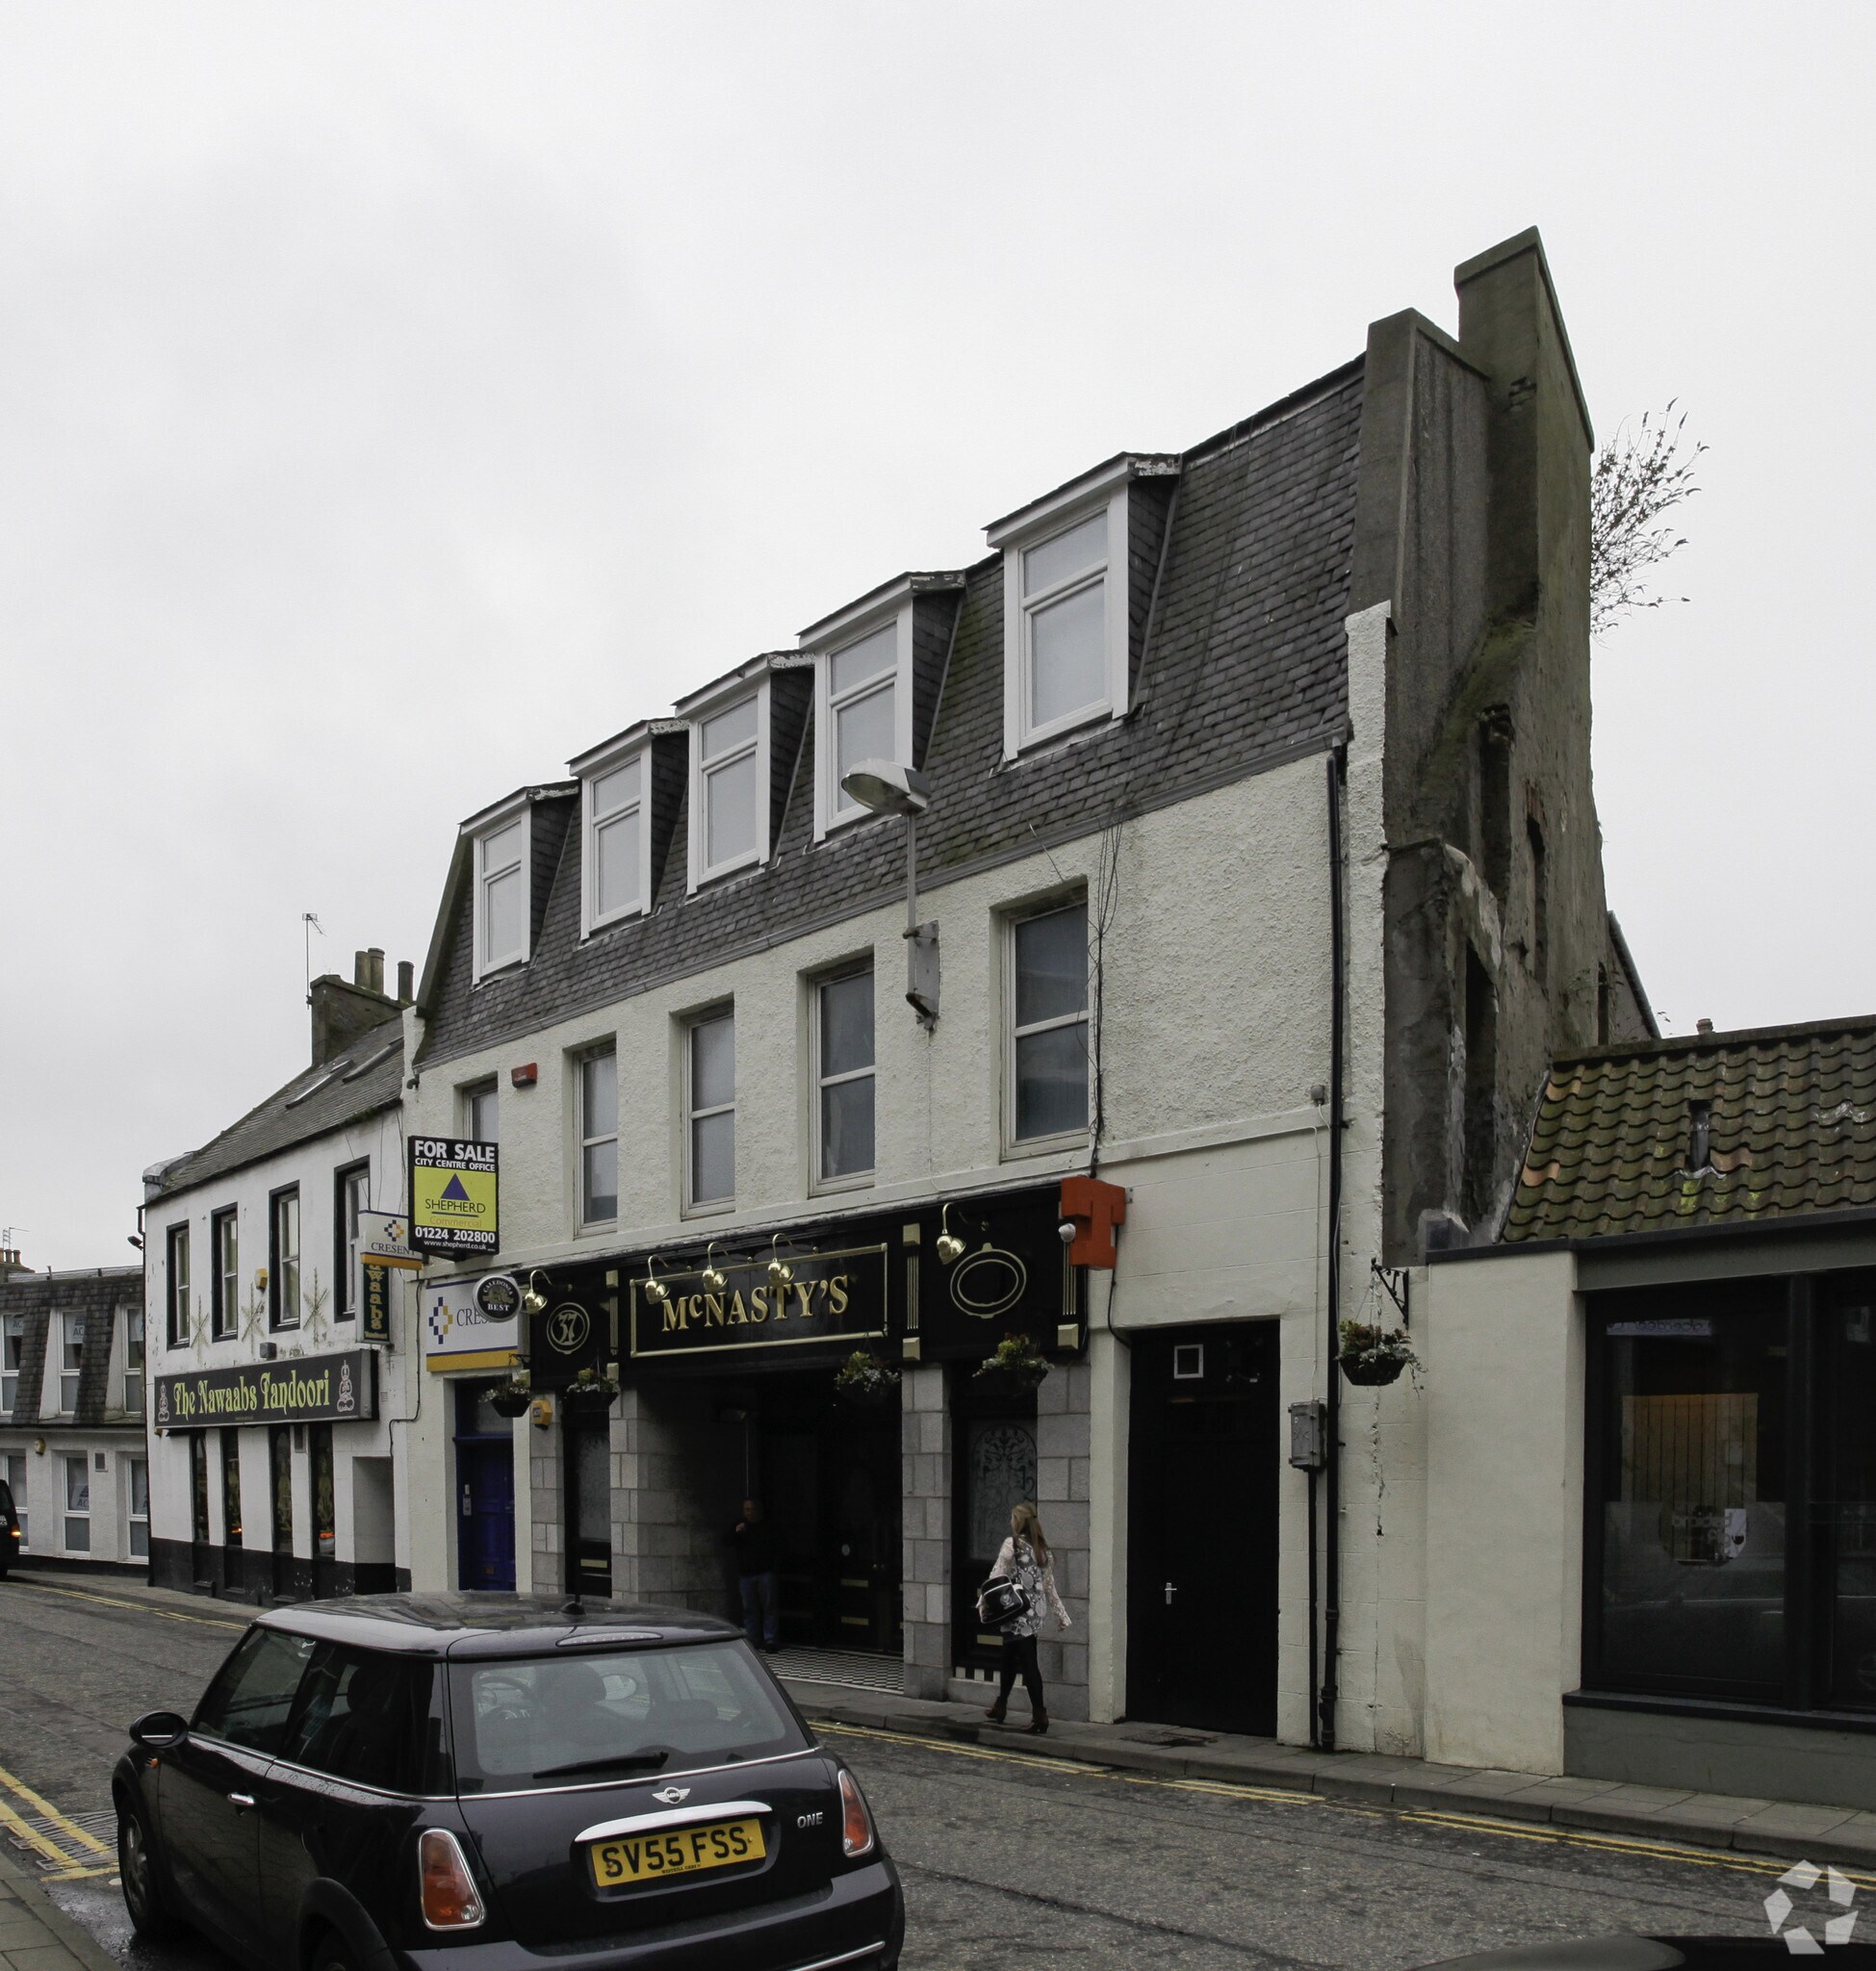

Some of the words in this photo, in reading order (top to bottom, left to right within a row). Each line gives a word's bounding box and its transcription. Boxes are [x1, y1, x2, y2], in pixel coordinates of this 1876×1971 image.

[415, 1140, 447, 1159] FOR
[454, 1143, 495, 1163] SALE
[415, 1158, 433, 1166] CITY
[436, 1159, 466, 1169] CENTRE
[469, 1162, 495, 1172] OFFICE
[424, 1198, 486, 1214] SHEPHERD
[429, 1216, 481, 1228] Commercial
[415, 1226, 449, 1240] 01224
[453, 1230, 495, 1243] 202800
[424, 1240, 486, 1250] www.shepherd.co.uk
[482, 1280, 514, 1296] CALEDONIA
[366, 1264, 385, 1330] waabs
[487, 1303, 510, 1312] BEST
[73, 1326, 85, 1337] AC
[557, 1312, 578, 1346] 37
[173, 1382, 195, 1421] The
[197, 1376, 258, 1414] Nawaabs
[260, 1369, 330, 1415] Tandoori
[77, 1497, 89, 1508] AC
[797, 1811, 823, 1829] ONE
[602, 1836, 684, 1878] SV55
[691, 1827, 749, 1863] FSS
